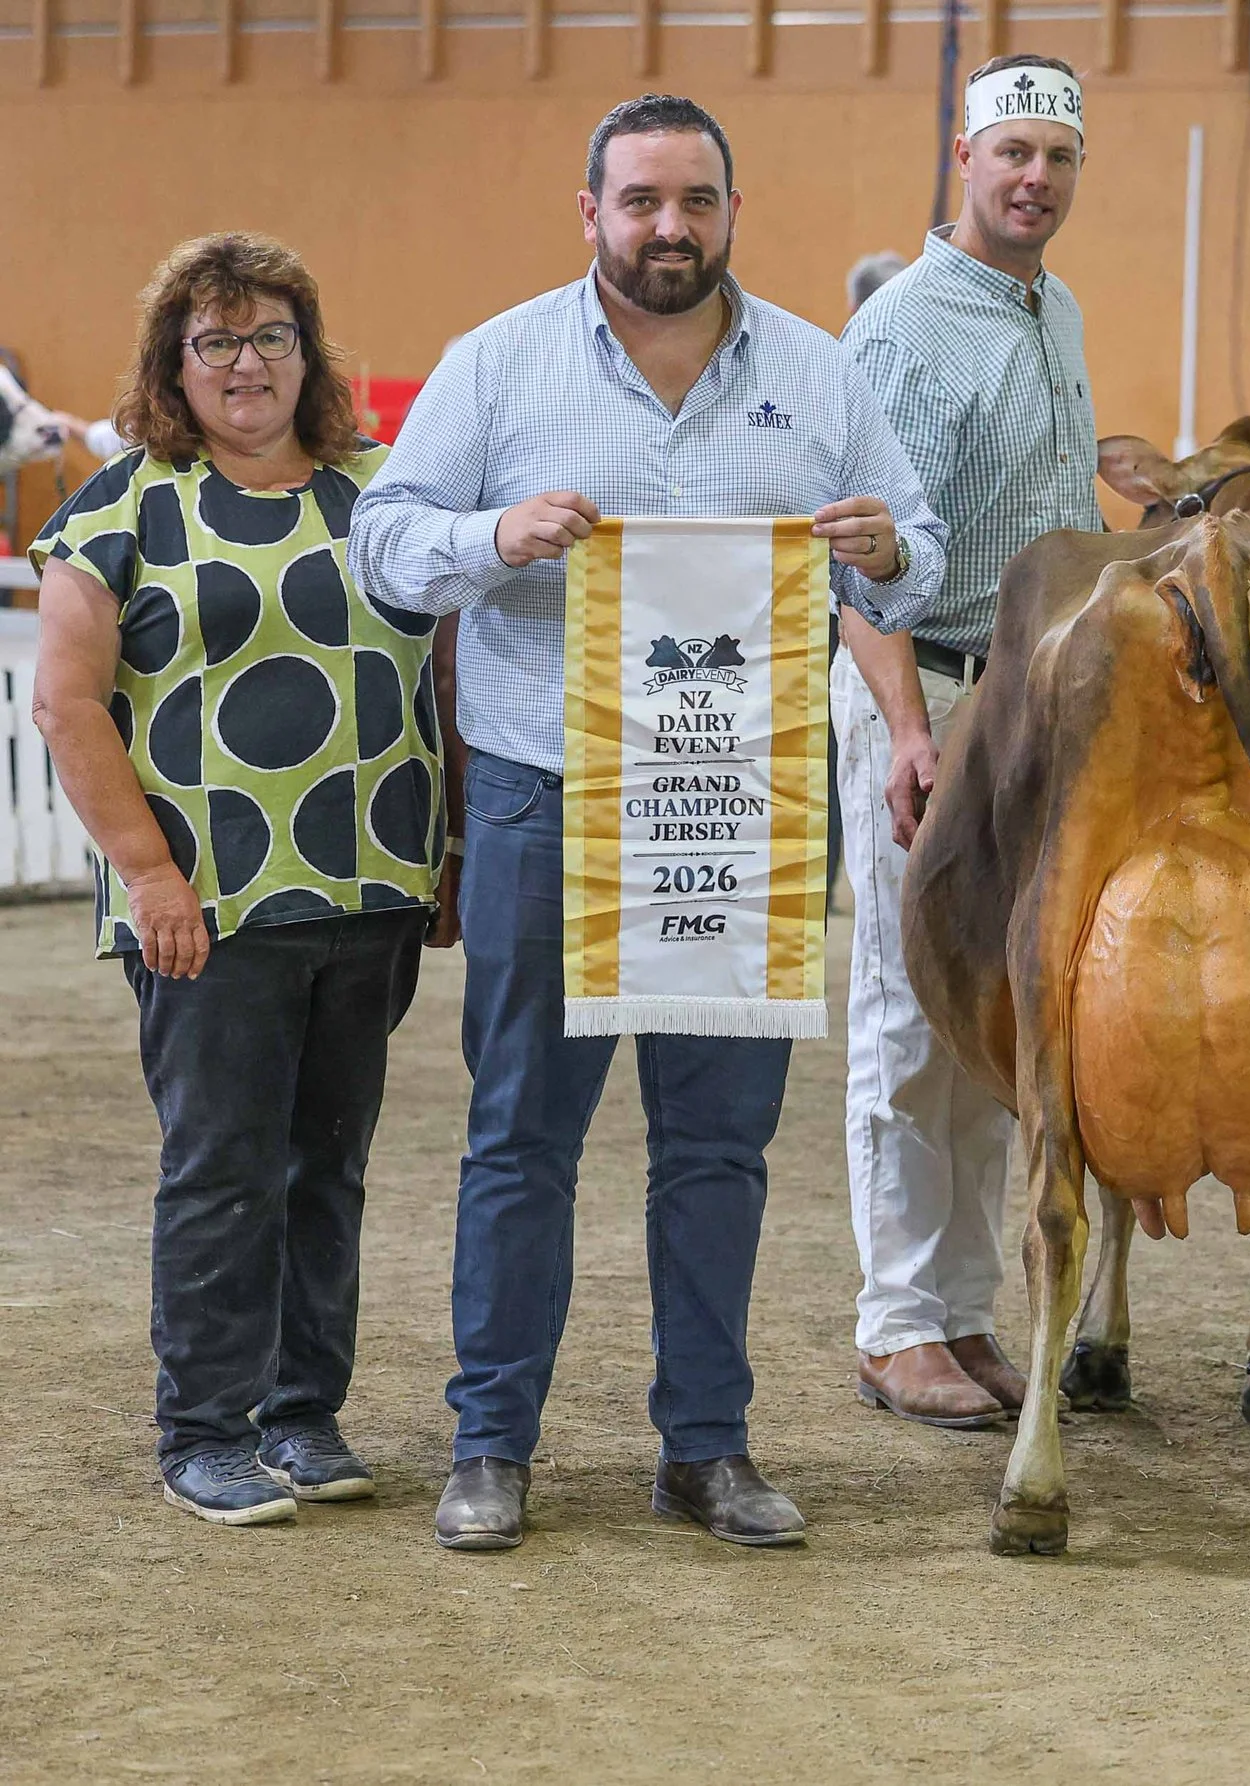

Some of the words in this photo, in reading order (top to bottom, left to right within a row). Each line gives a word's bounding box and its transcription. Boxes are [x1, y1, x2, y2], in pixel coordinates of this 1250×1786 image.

[995, 92, 1057, 117] SEMEX
[748, 411, 793, 430] SEMEX
[687, 644, 702, 654] NZ
[679, 691, 713, 709] NZ
[657, 713, 737, 733] DAIRY
[653, 736, 741, 754] EVENT
[652, 775, 741, 793] GRAND
[626, 798, 766, 818] CHAMPION
[649, 822, 741, 842] JERSEY
[652, 864, 738, 893] 2026
[661, 914, 726, 935] FMG
